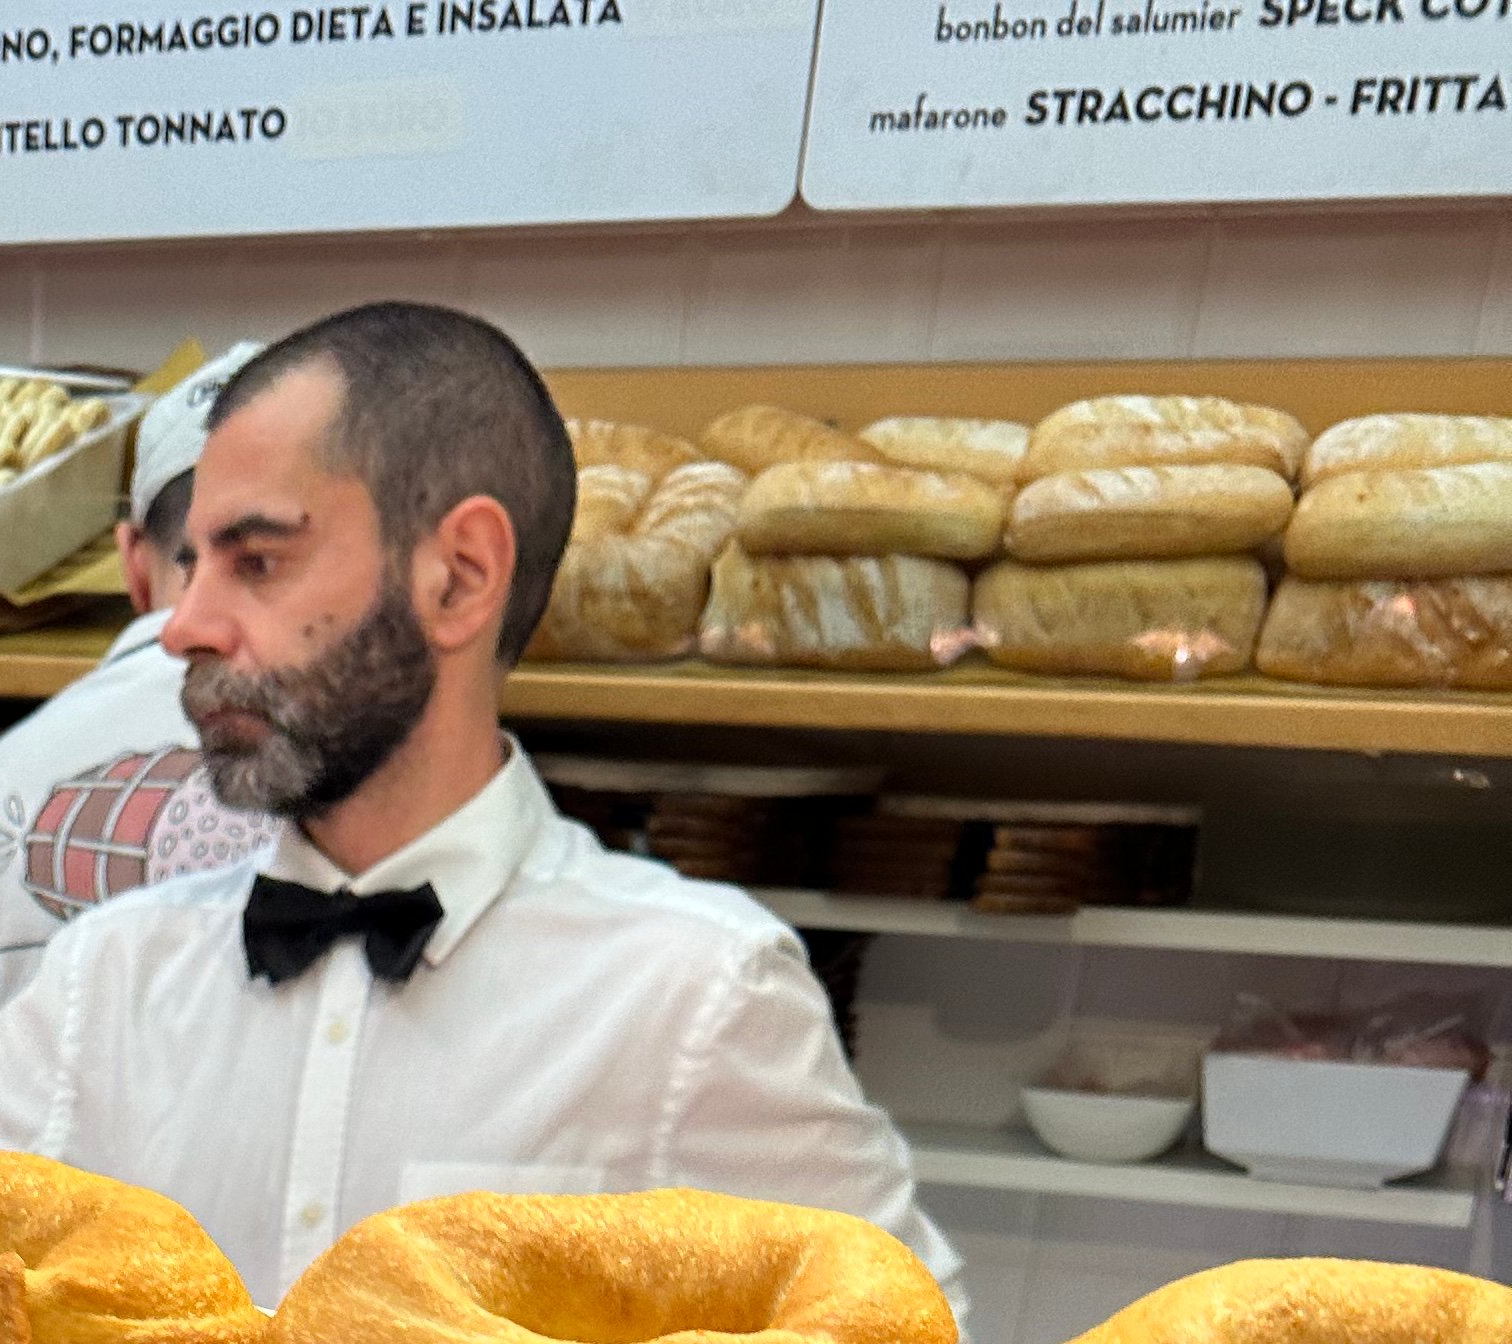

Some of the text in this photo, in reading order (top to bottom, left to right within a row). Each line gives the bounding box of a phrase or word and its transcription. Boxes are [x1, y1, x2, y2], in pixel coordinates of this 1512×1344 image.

[68, 12, 280, 60] FORMAGGIO
[290, 3, 395, 45] DIETA
[406, 3, 427, 37] E
[436, 0, 624, 36] INSALATA
[935, 1, 1048, 43] bonbon
[1056, 0, 1103, 37] del
[1110, 0, 1241, 36] salumier
[118, 106, 287, 149] TONNATO
[868, 92, 1008, 132] mafarone
[1024, 79, 1313, 126] STRACCHINO
[1350, 73, 1507, 115] FRITTA
